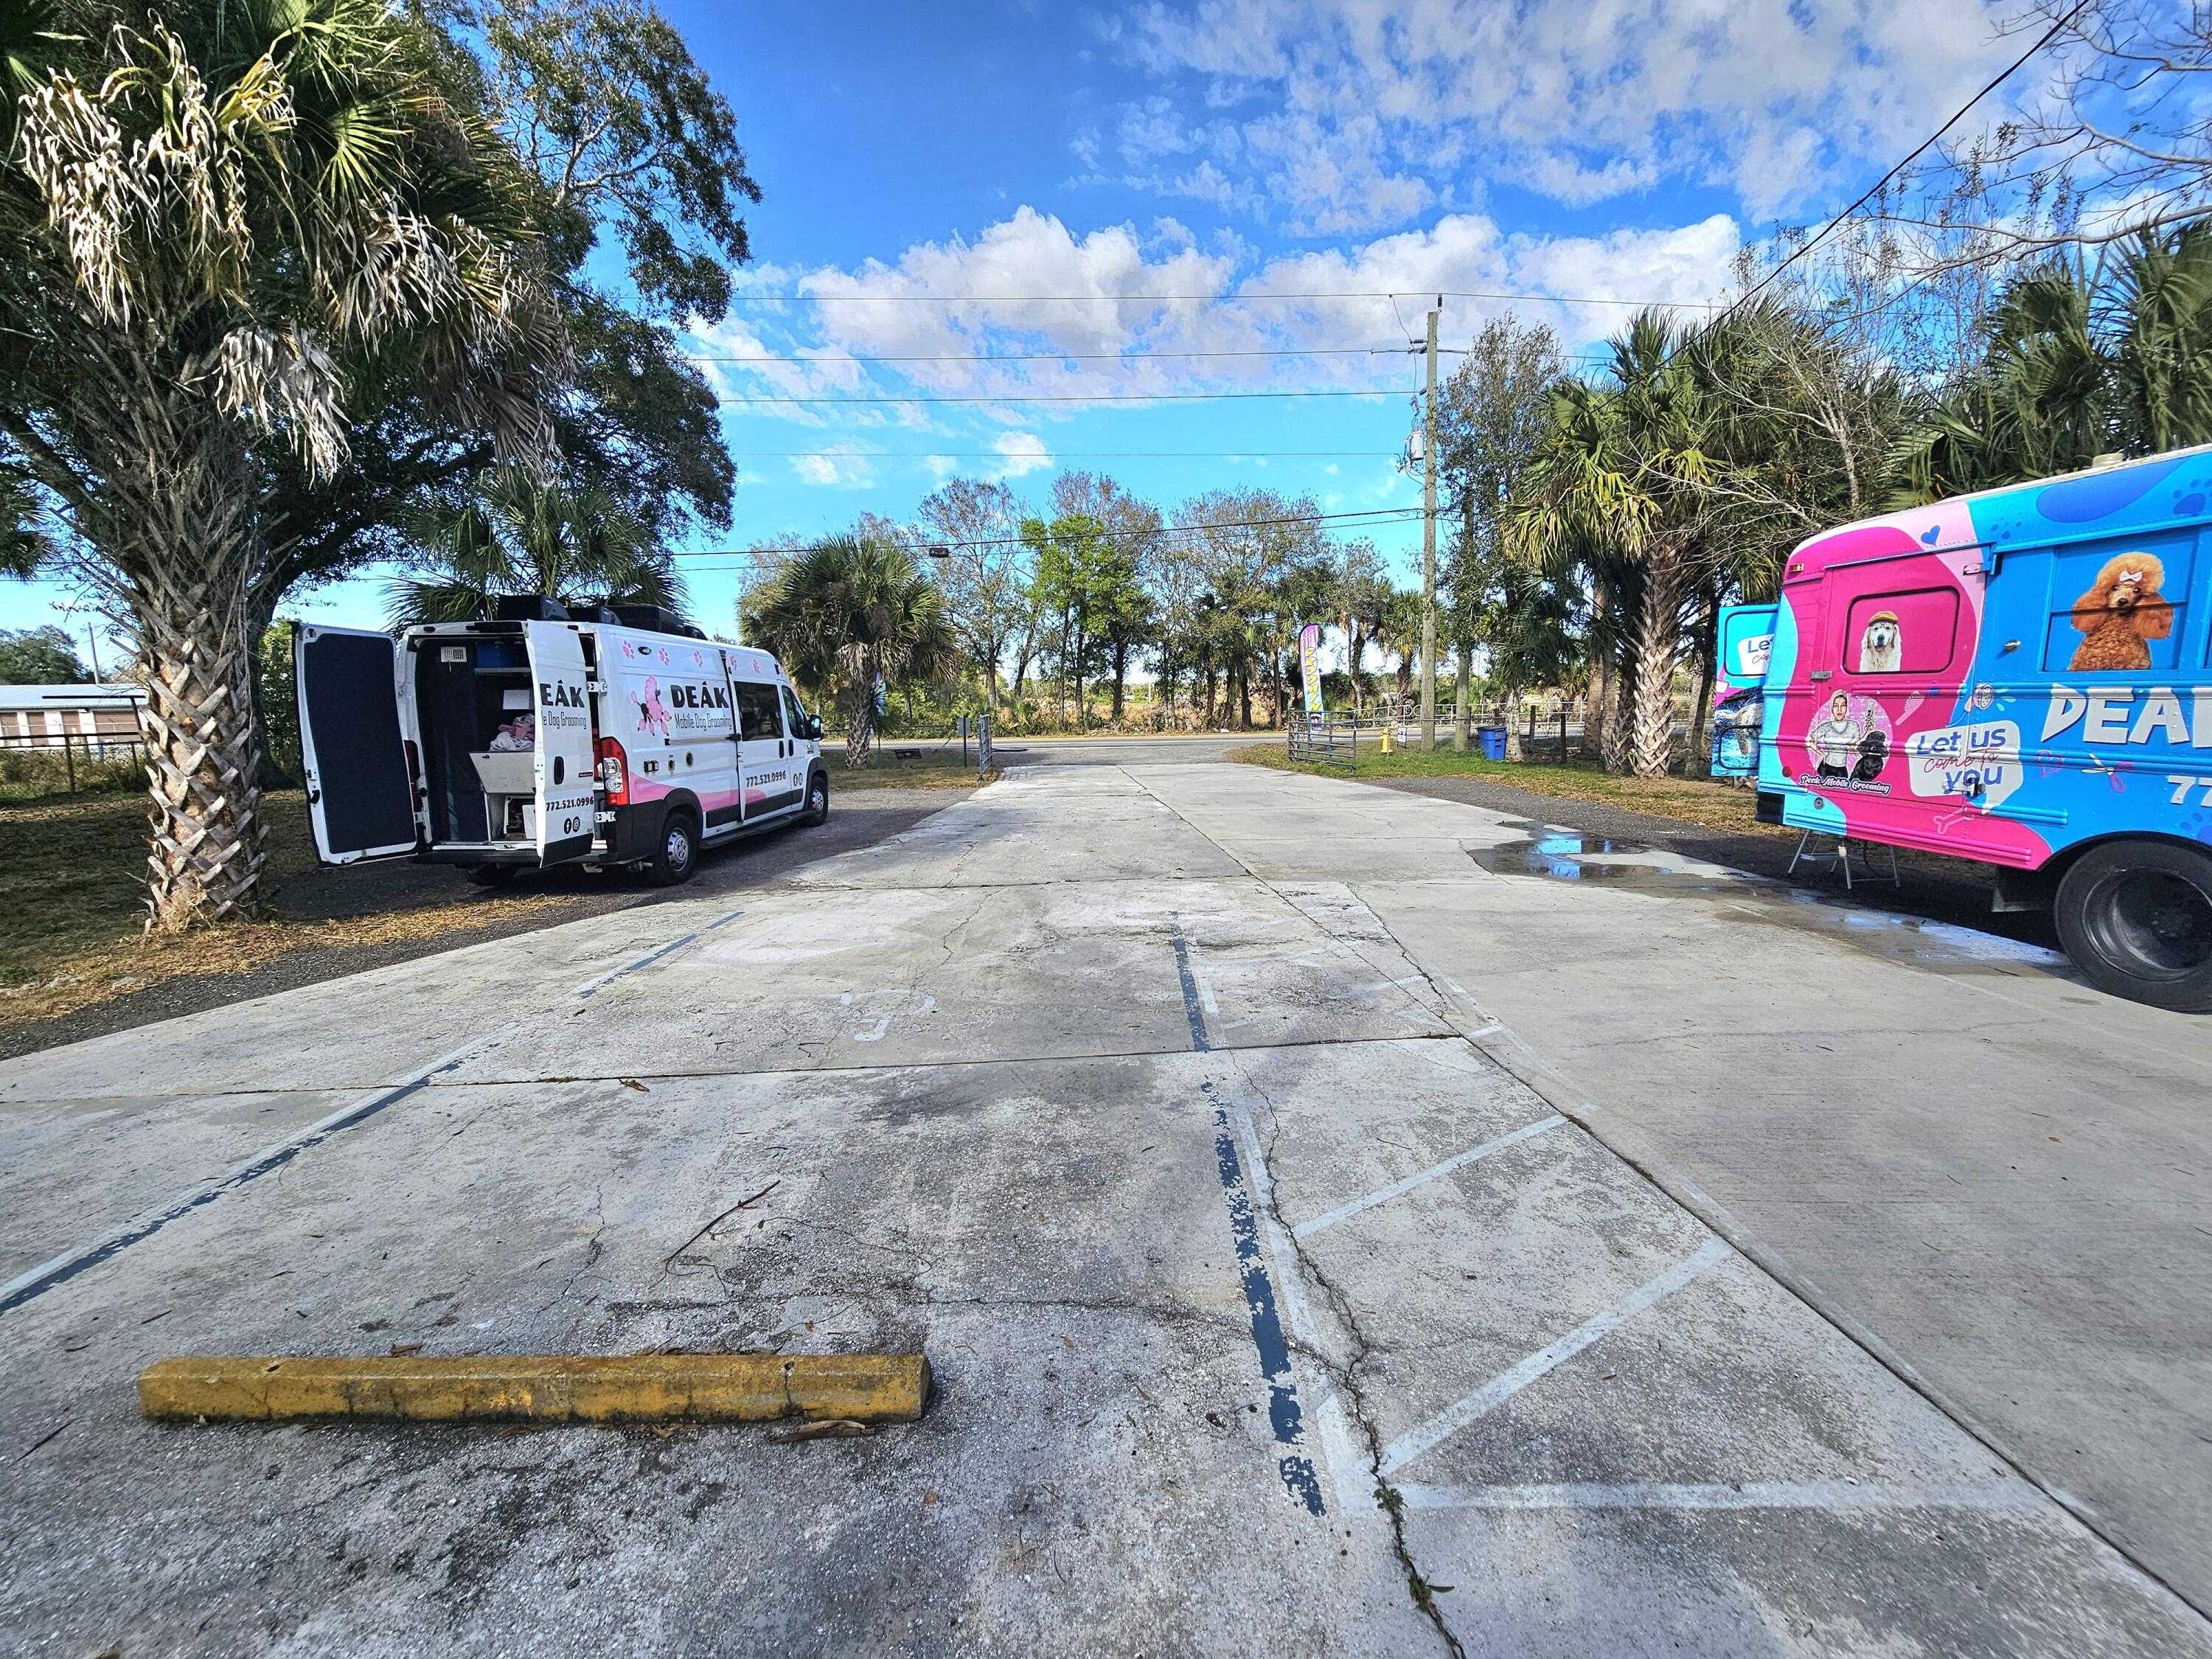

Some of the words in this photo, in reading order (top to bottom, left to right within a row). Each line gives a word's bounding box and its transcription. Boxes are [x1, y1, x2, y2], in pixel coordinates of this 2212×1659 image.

[561, 712, 587, 729] Grooming
[674, 713, 694, 728] Mobile
[695, 713, 706, 731] Dog
[707, 713, 732, 731] Grooming
[1917, 731, 1961, 755] Let
[1972, 728, 2006, 748] us
[1924, 755, 1974, 773] come
[745, 771, 787, 787] 772.521.0996
[1823, 776, 1848, 787] Mobile
[1851, 779, 1890, 794] Grooming
[1943, 766, 2003, 794] you
[546, 796, 594, 812] 772.521.0996
